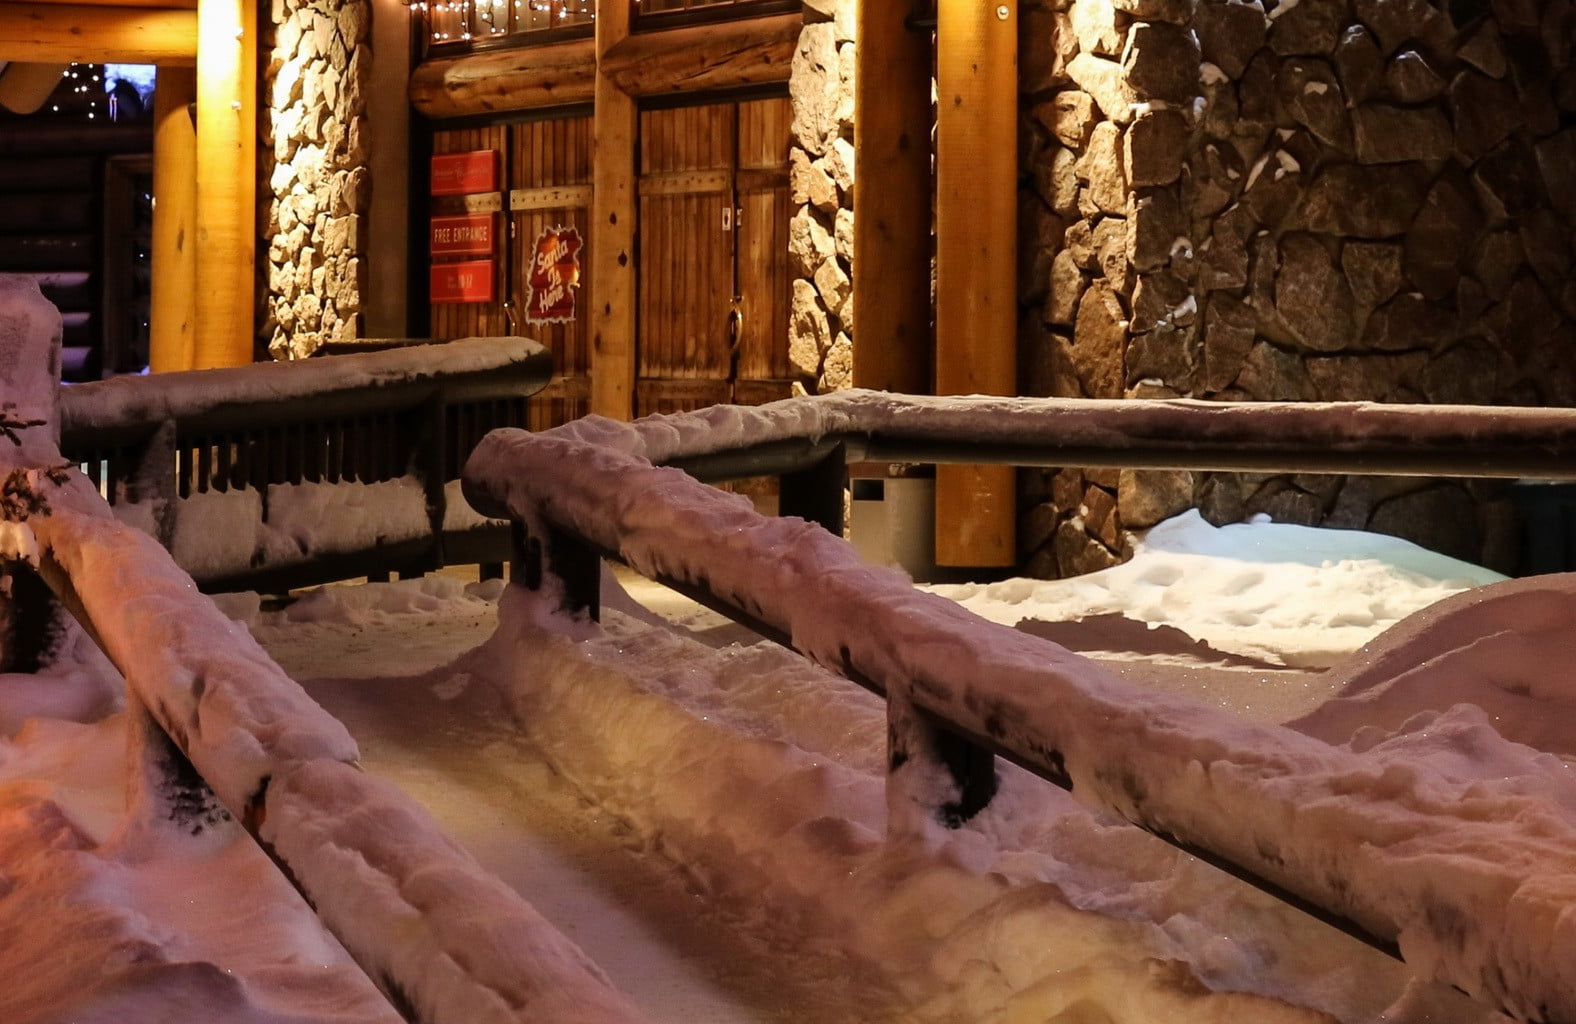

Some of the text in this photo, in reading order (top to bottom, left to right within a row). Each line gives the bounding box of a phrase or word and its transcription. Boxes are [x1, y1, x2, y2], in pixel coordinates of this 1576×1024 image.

[434, 226, 487, 243] FREE ENTRANCE
[537, 240, 568, 275] Santa
[548, 266, 561, 290] Is
